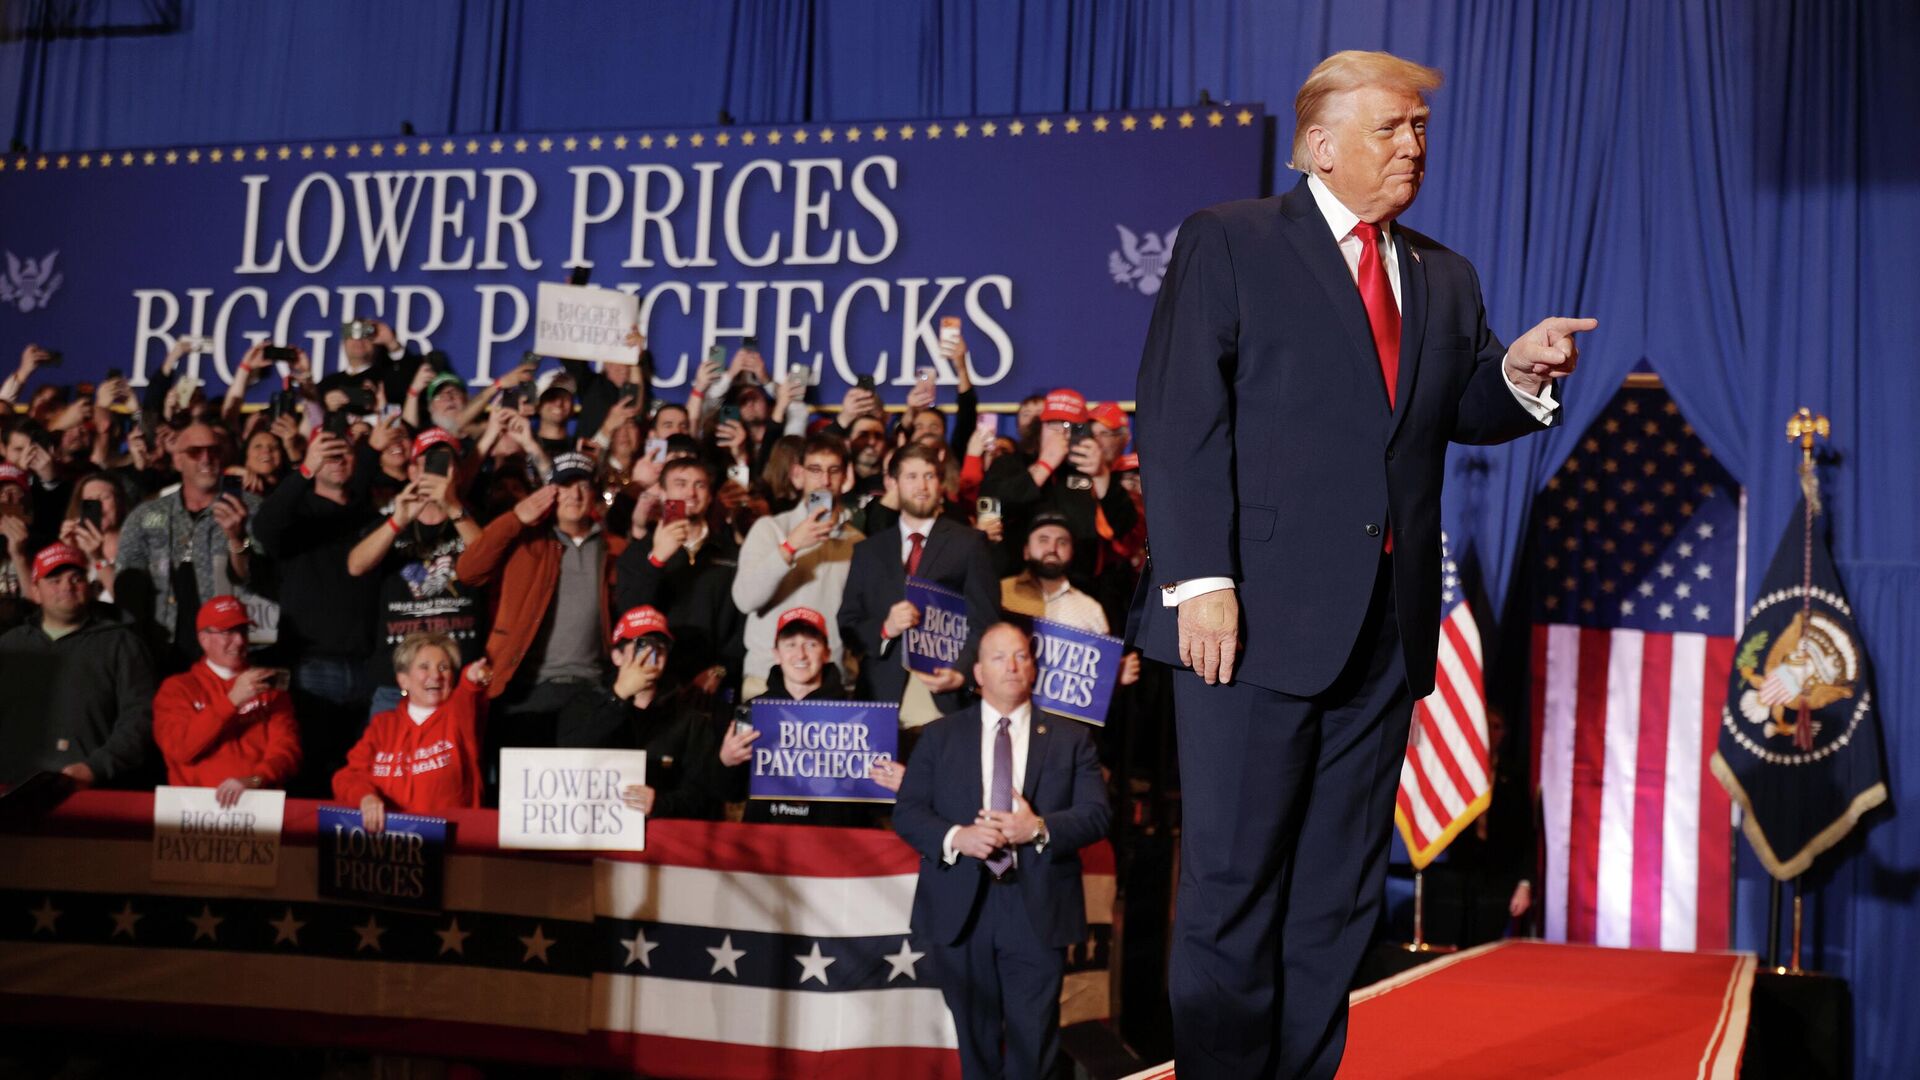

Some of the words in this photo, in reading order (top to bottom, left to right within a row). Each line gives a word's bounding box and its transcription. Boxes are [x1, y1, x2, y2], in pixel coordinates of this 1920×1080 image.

[234, 168, 543, 274] LOWER
[561, 155, 899, 269] PRICES
[557, 301, 622, 328] BIGGER
[467, 274, 1014, 389] PCHECKS
[540, 320, 632, 347] PAYCHECK
[1031, 632, 1101, 679] OWER
[1032, 664, 1095, 708] ICES
[779, 720, 870, 750] BIGGER
[522, 768, 624, 800] LOWER
[180, 810, 256, 836] BIGGER
[522, 802, 623, 835] PRICES
[158, 836, 276, 865] PAYCHECKS
[334, 823, 426, 865] LOWER
[335, 857, 425, 898] PRICES
